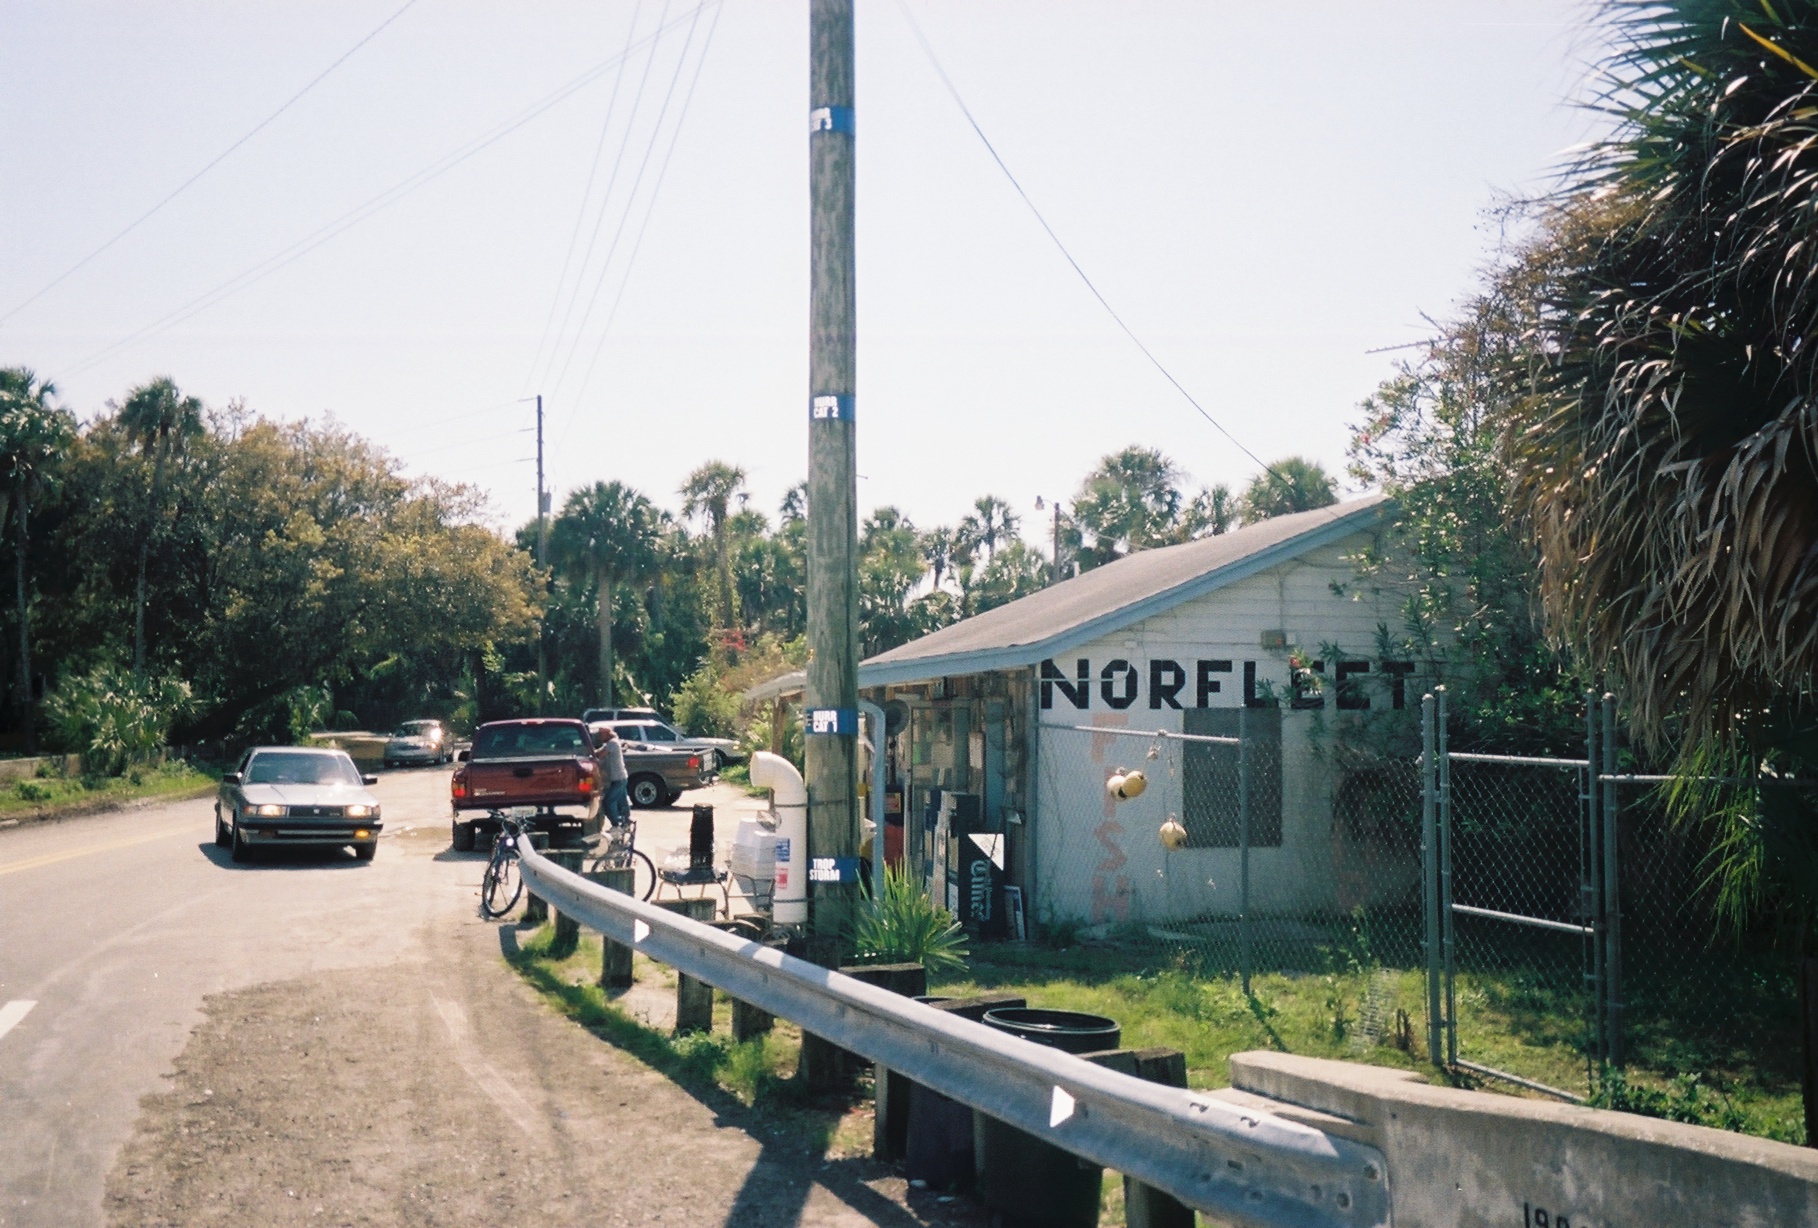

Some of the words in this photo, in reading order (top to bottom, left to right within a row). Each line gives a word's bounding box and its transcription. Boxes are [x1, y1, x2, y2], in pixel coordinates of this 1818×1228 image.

[1040, 658, 1415, 710] NORFLEET
[813, 721, 828, 732] CAT
[813, 858, 836, 870] TROP
[809, 869, 840, 881] STORM
